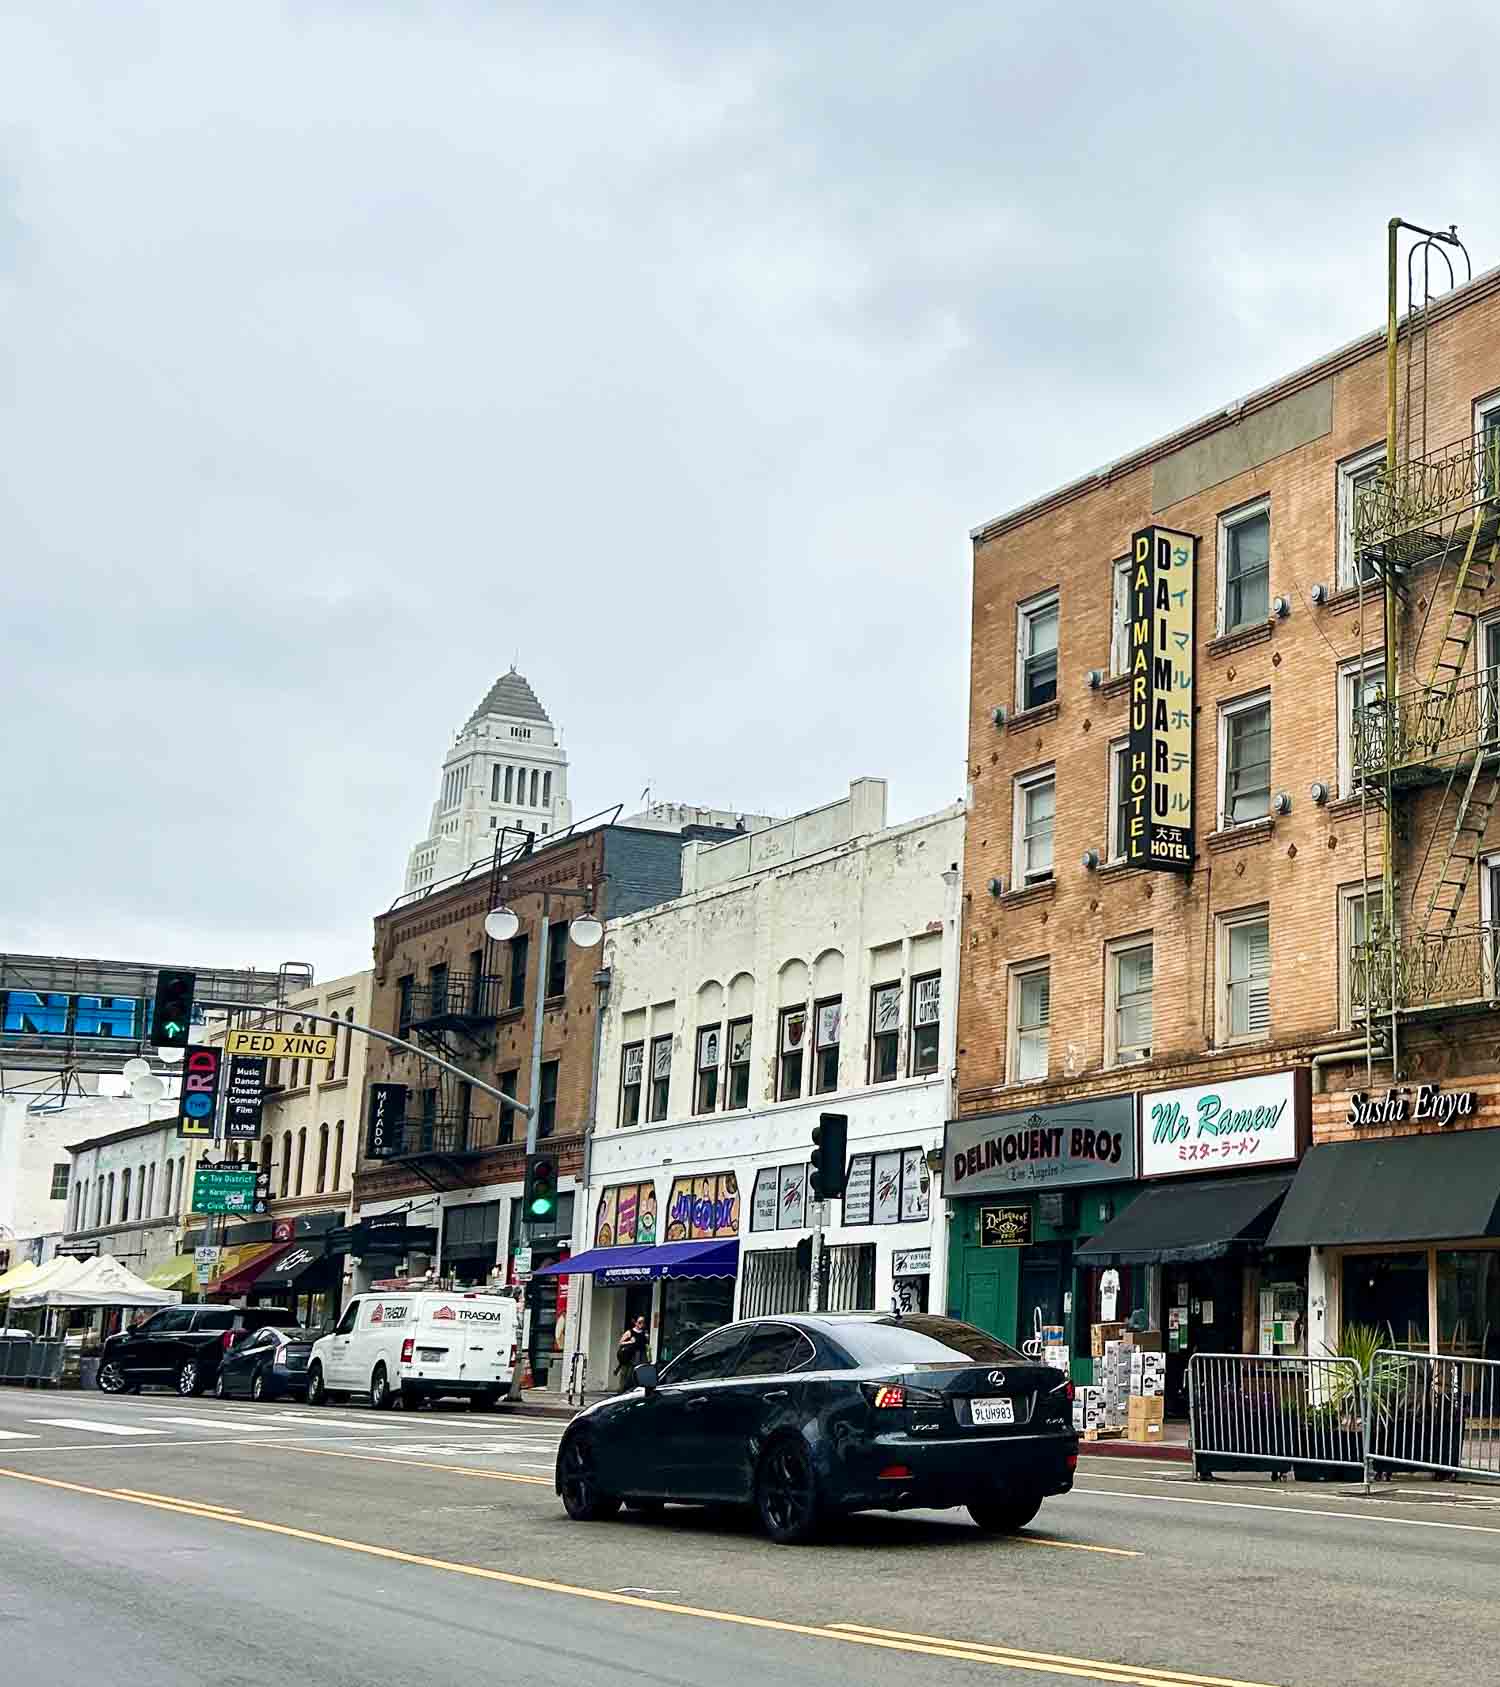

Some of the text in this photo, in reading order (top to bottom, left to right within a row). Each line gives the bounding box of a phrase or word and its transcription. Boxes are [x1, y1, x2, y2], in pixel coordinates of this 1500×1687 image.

[1133, 536, 1149, 731] DAIMARU
[1153, 537, 1172, 817] DAIMARU
[1130, 751, 1147, 858] HOTEL
[1151, 840, 1191, 860] HOTEL
[236, 1034, 327, 1055] PED XING
[234, 1077, 260, 1085] Dance
[236, 1067, 260, 1076] Music
[229, 1096, 262, 1106] Comedy
[231, 1086, 262, 1095] Theater
[236, 1106, 253, 1114] Film
[1345, 1084, 1473, 1127] Sushi Enya
[374, 1091, 387, 1146] MIKADO
[1151, 1094, 1288, 1144] Mr Ramen
[954, 1127, 1122, 1182] DELINQUENT BROS
[1178, 1136, 1260, 1161] ミスターラーメン
[224, 1174, 252, 1183] District
[458, 1310, 501, 1321] TRASOM
